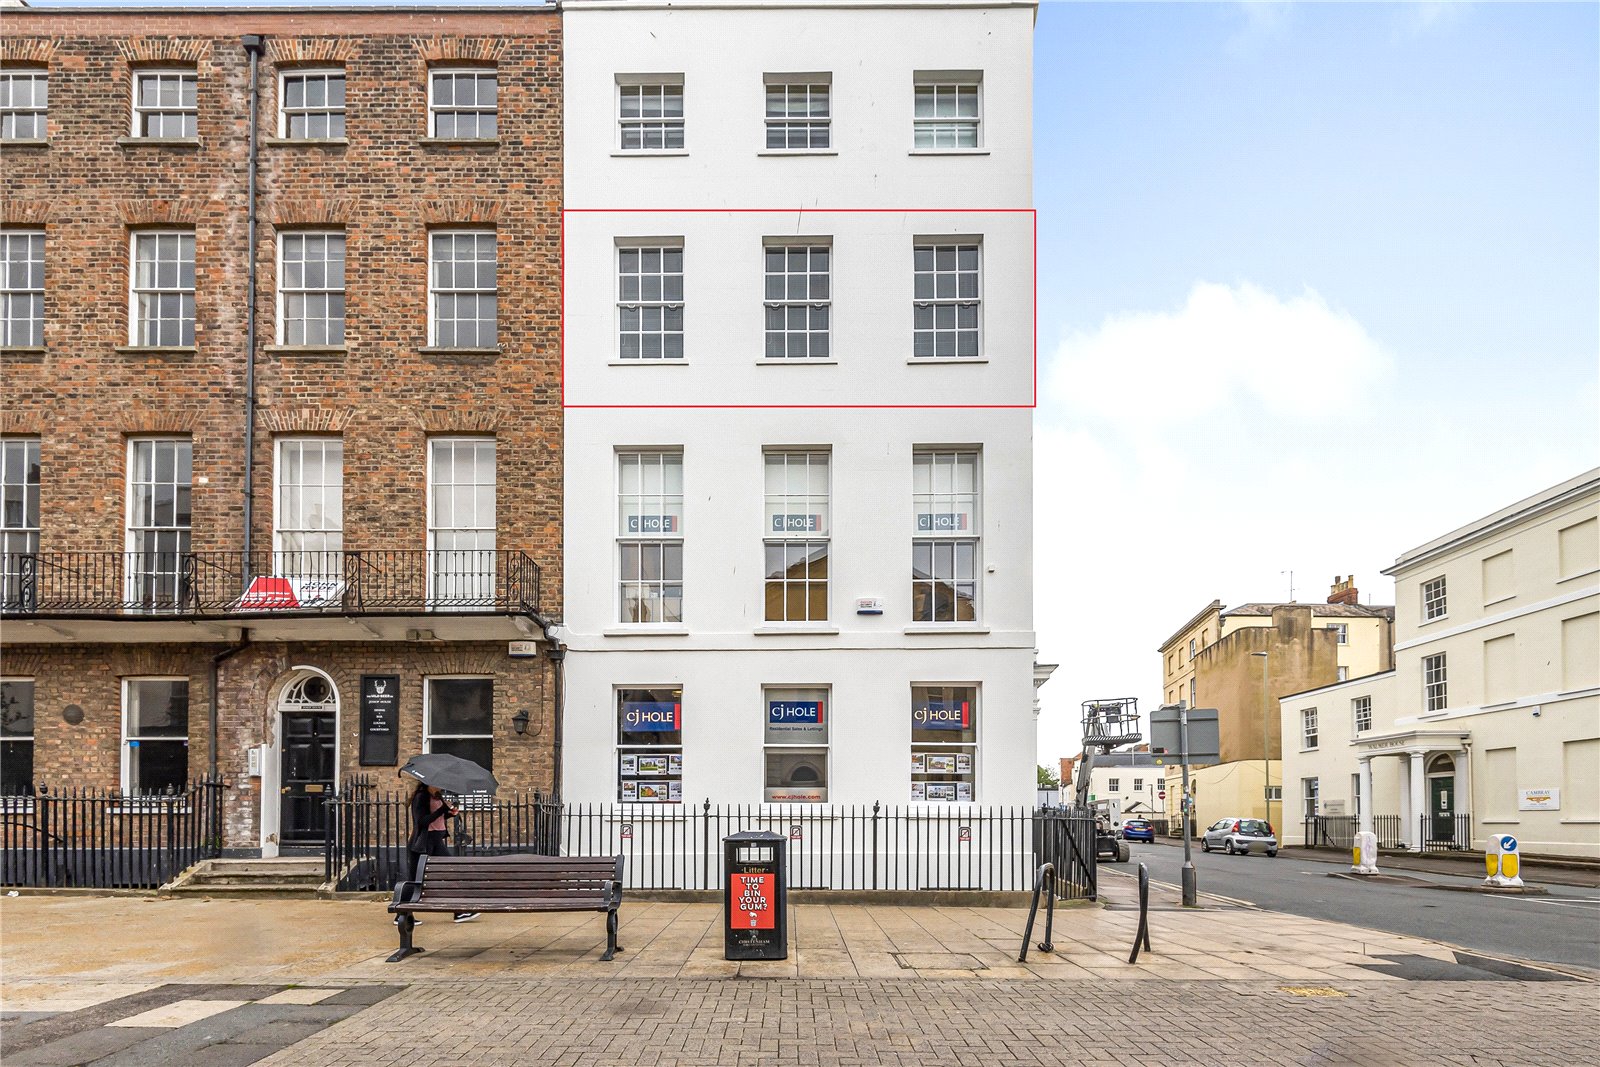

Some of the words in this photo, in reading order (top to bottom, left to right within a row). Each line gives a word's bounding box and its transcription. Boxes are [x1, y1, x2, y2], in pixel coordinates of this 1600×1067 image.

[644, 519, 670, 528] HOE
[787, 518, 814, 527] HOLE
[934, 517, 960, 526] HOLE
[641, 711, 673, 722] HOLE
[786, 707, 816, 717] HOLE
[930, 710, 961, 720] HOLE
[740, 876, 765, 884] TIME
[739, 896, 766, 904] YOUR
